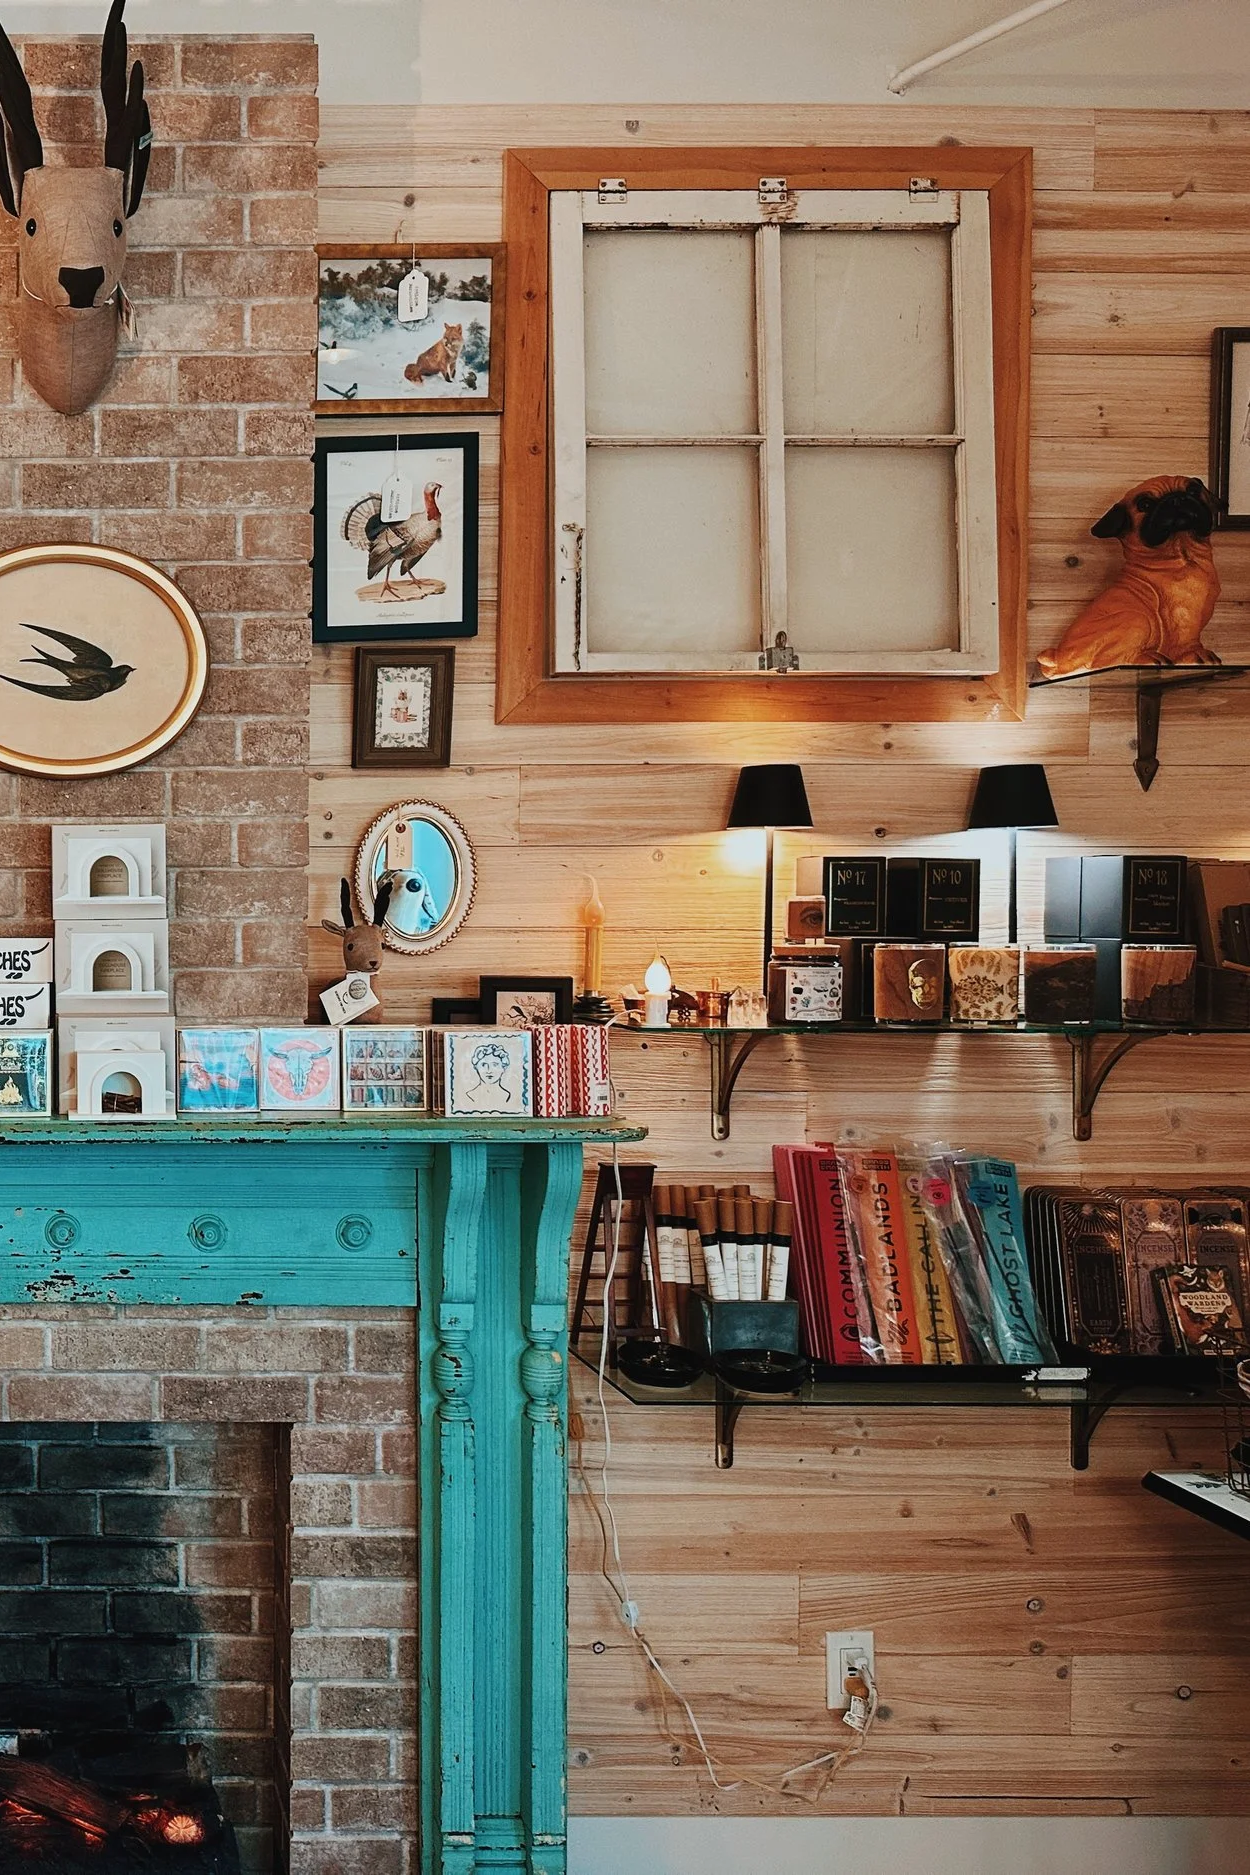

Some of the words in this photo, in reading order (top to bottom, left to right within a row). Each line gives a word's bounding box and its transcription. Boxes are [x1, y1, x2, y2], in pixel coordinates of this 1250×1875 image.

[854, 871, 866, 886] 17
[949, 869, 962, 885] 10
[1156, 869, 1168, 886] 18
[992, 1182, 1016, 1242] LAKE
[828, 1178, 859, 1319] COMMUNION
[871, 1182, 903, 1312] BADLANDS
[1137, 1244, 1174, 1253] INCENSE
[1199, 1244, 1235, 1254] INCENSE
[1002, 1243, 1026, 1319] GHOST
[924, 1283, 949, 1325] THE
